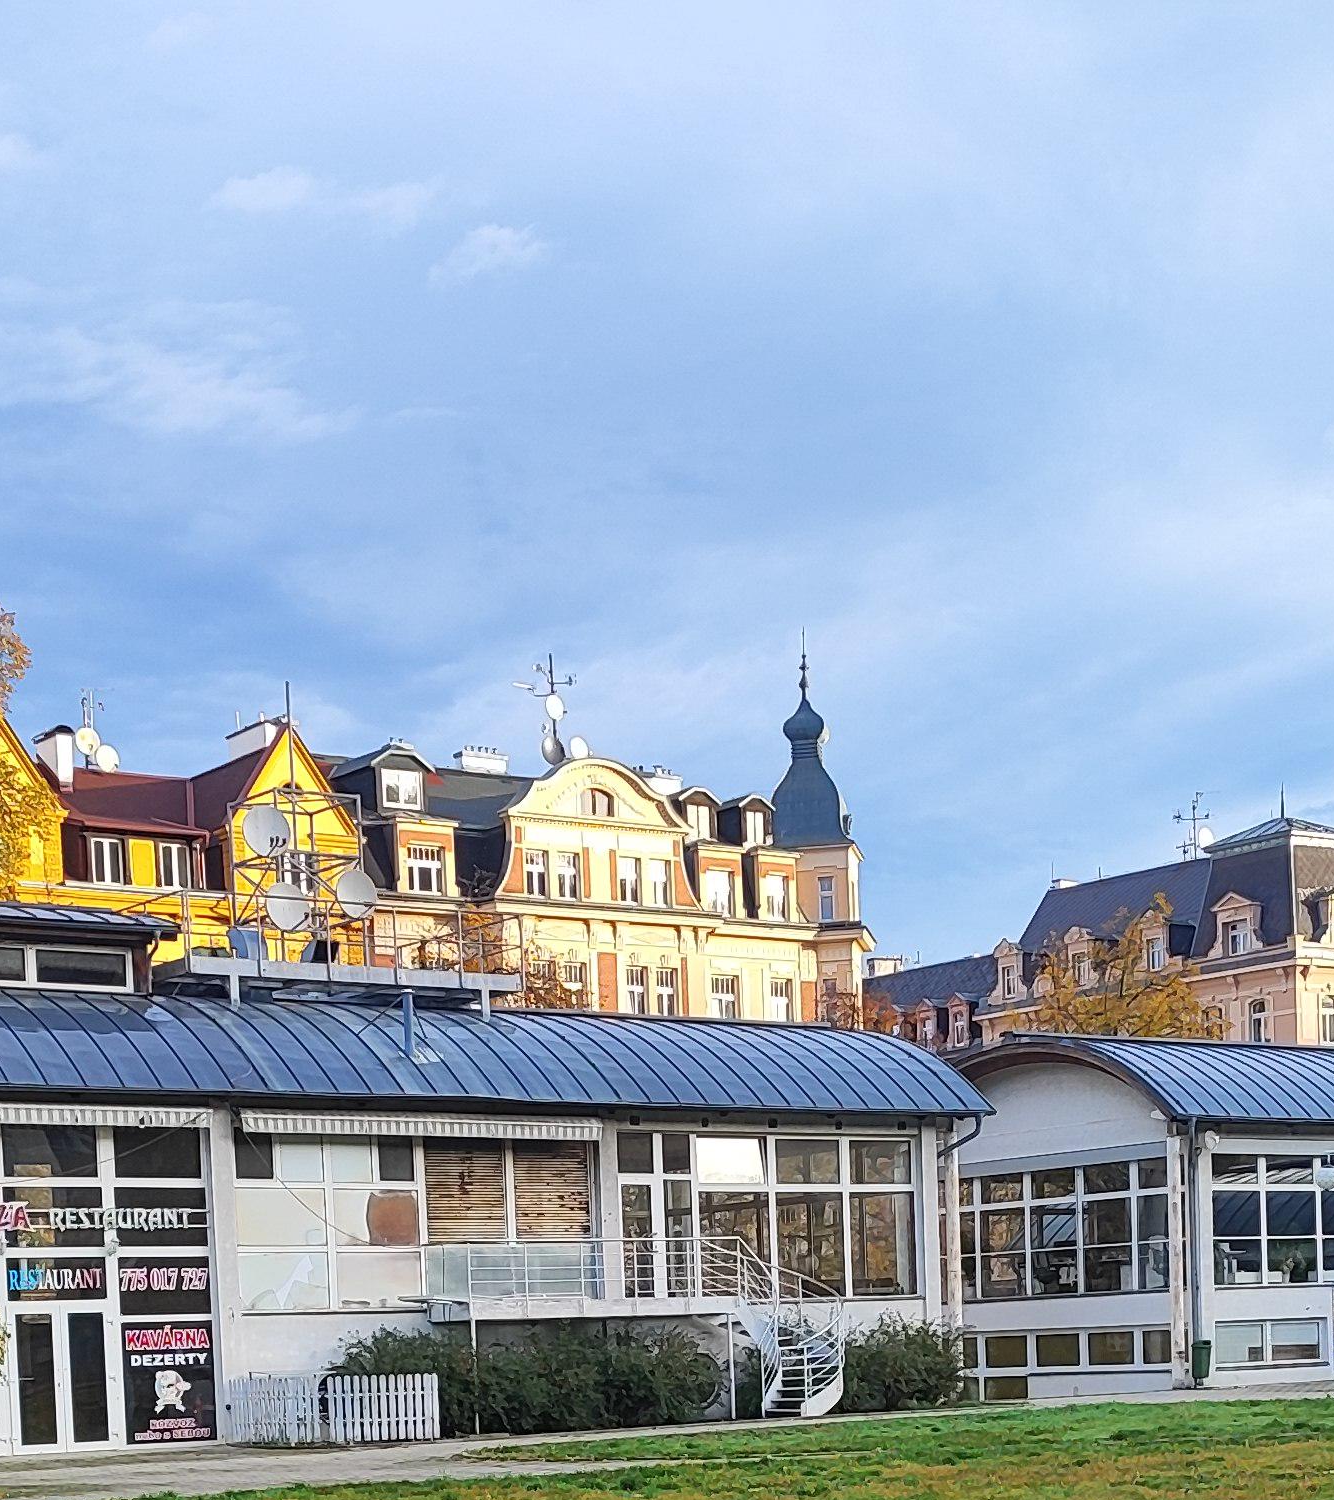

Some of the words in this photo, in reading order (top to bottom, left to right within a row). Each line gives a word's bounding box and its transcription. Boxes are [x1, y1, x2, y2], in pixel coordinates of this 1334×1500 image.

[49, 1207, 192, 1232] RESTAURANT
[8, 1267, 103, 1291] RESTAURANT
[120, 1267, 148, 1291] 775
[149, 1267, 179, 1290] 017
[180, 1267, 208, 1290] 727
[125, 1324, 210, 1351] KAVÁRNA
[130, 1352, 208, 1367] DEZERTY
[149, 1418, 196, 1429] ROZVOZ
